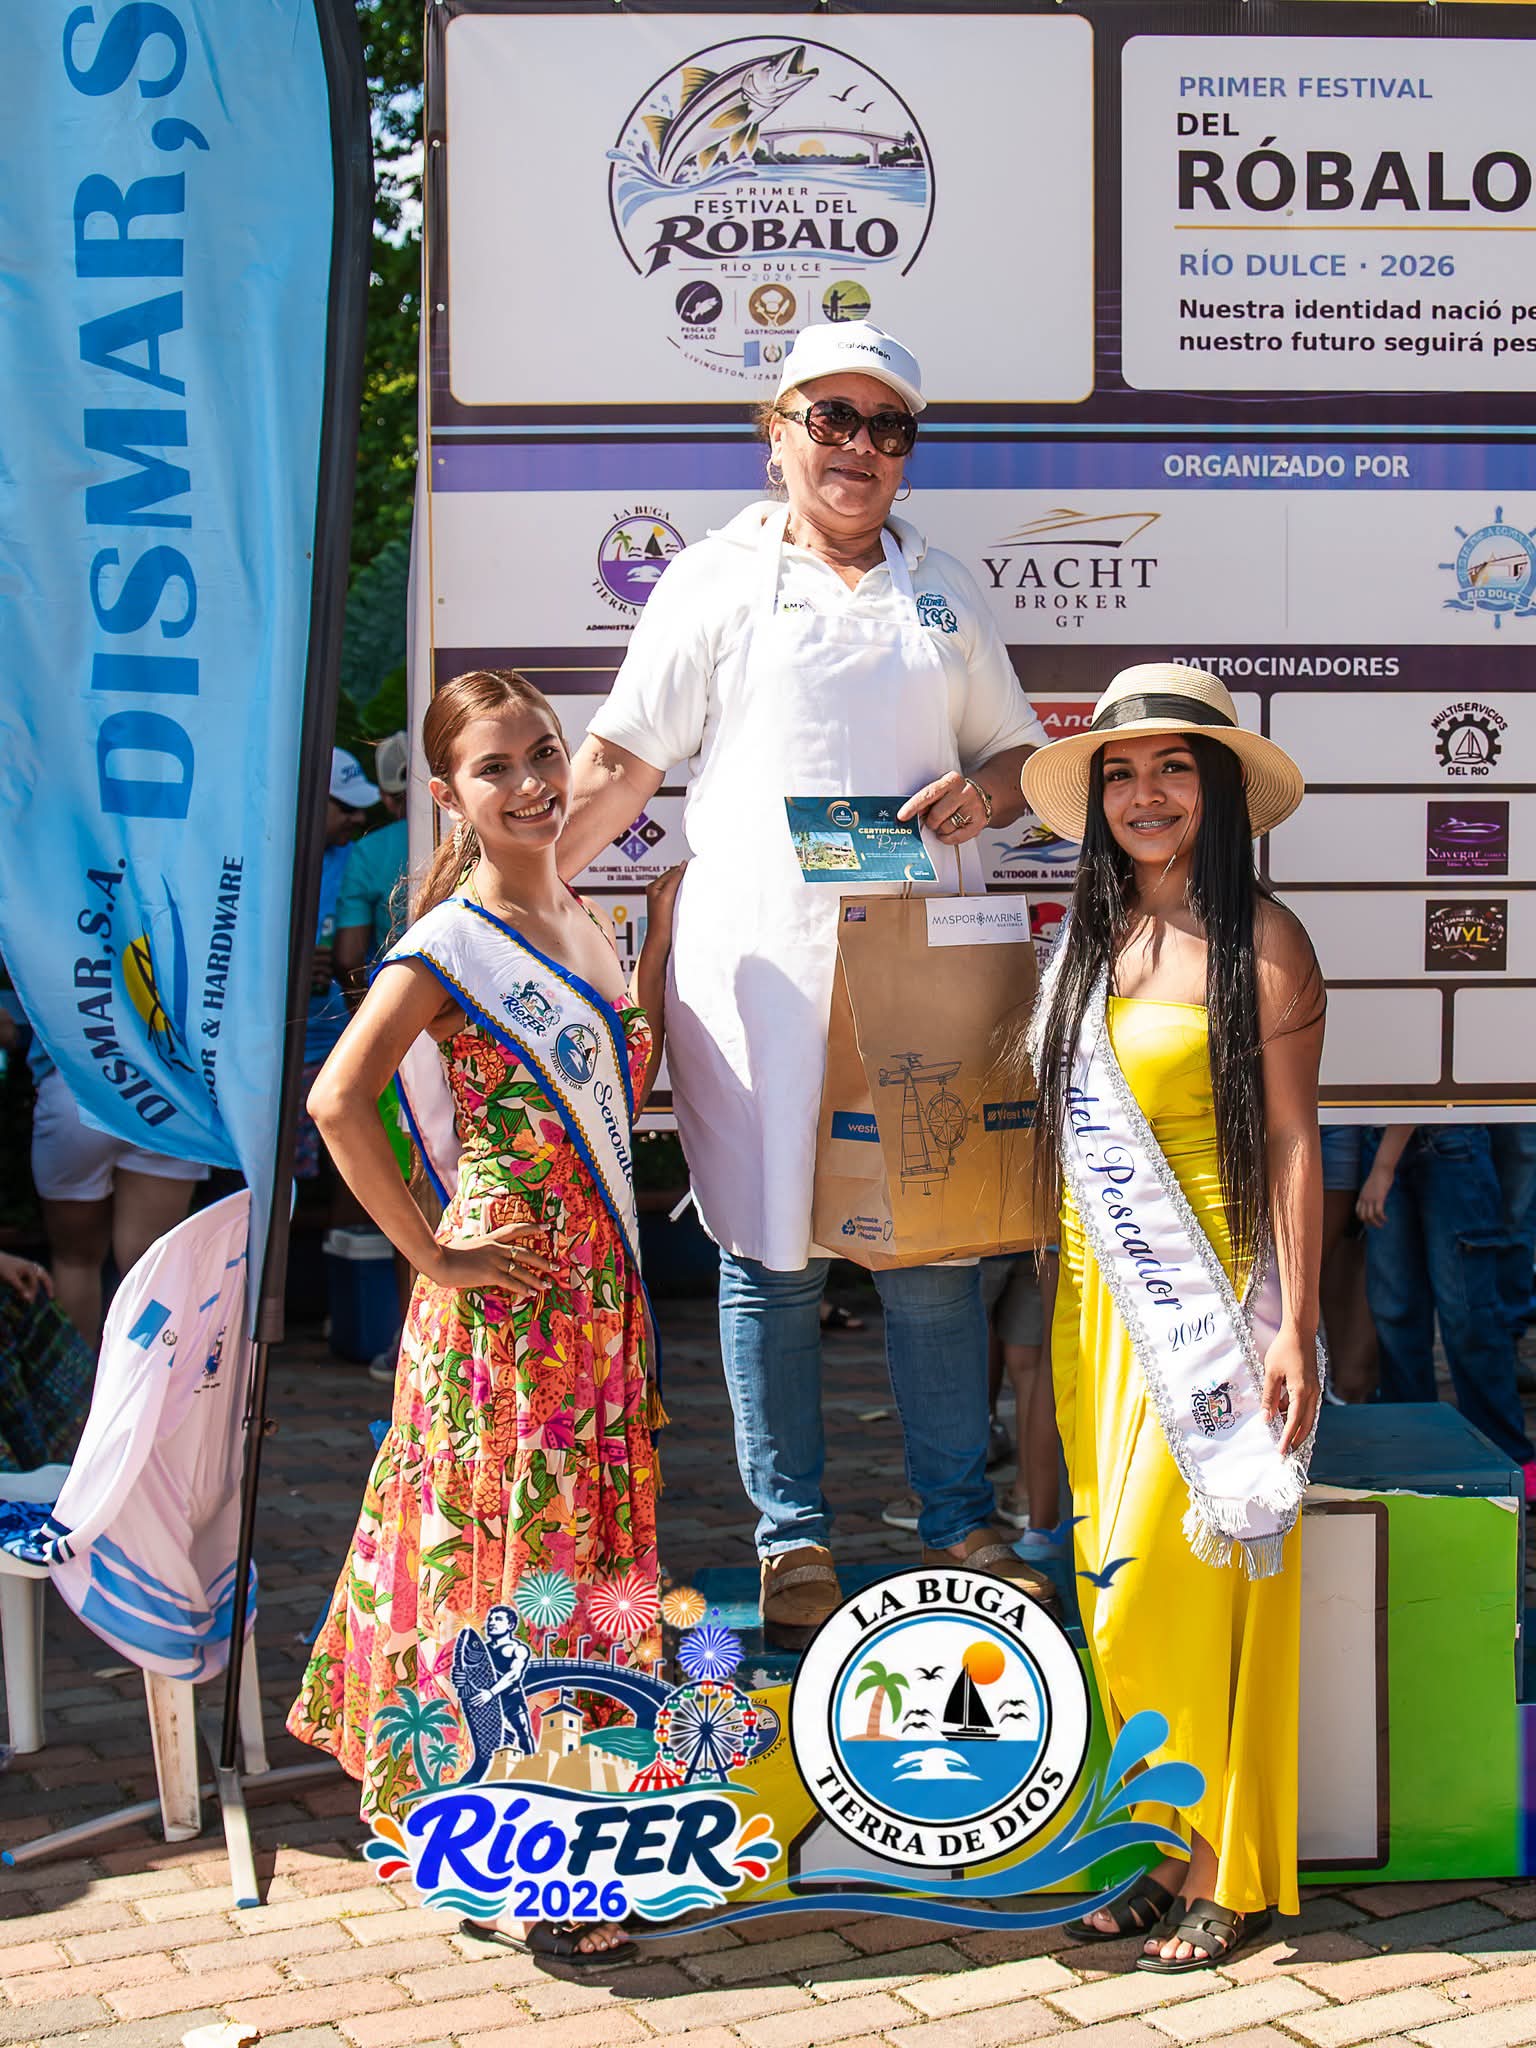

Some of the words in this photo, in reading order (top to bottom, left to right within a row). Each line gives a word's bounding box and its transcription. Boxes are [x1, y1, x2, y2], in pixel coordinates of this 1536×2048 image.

[1179, 76, 1287, 98] PRIMER
[1299, 77, 1433, 99] FESTIVAL
[1177, 112, 1239, 136] DEL
[1178, 136, 1532, 213] RÓBALO
[736, 187, 810, 196] PRIMER
[694, 199, 804, 214] FESTIVAL
[816, 199, 857, 213] DEL
[644, 216, 899, 278] RÓBALO
[763, 263, 822, 272] DULCE
[1179, 249, 1233, 277] RÍO
[1246, 254, 1347, 277] DULCE
[1380, 254, 1455, 278] 2026
[752, 273, 792, 282] 2026
[1179, 299, 1284, 319] Nuestra
[1295, 297, 1421, 320] identidad
[1431, 299, 1501, 320] nació
[869, 344, 891, 361] Klein
[1179, 332, 1283, 352] nuestro
[1291, 331, 1375, 352] futuro
[1384, 331, 1483, 356] seguirá
[1164, 455, 1346, 478] ORGANIZADO
[1354, 455, 1410, 478] POR
[612, 508, 631, 522] LA
[634, 506, 671, 521] BUGA
[981, 558, 1158, 588] YACHT
[592, 577, 638, 617] TIERRA
[1015, 594, 1127, 609] BROKER
[1055, 615, 1084, 628] GT
[1431, 702, 1508, 731] MULTISERVICIOS
[1447, 766, 1468, 776] DEL
[1471, 766, 1489, 776] RIO
[858, 827, 912, 835] CERTIFICADO
[992, 869, 1039, 879] OUTDOOR
[985, 912, 1023, 922] MARINE
[202, 856, 244, 1011] HARDWARE
[1444, 926, 1490, 942] WYL
[200, 1017, 221, 1039] &
[1063, 1087, 1111, 1138] del
[1086, 1145, 1183, 1310] Pescador
[1167, 1312, 1216, 1352] 2026
